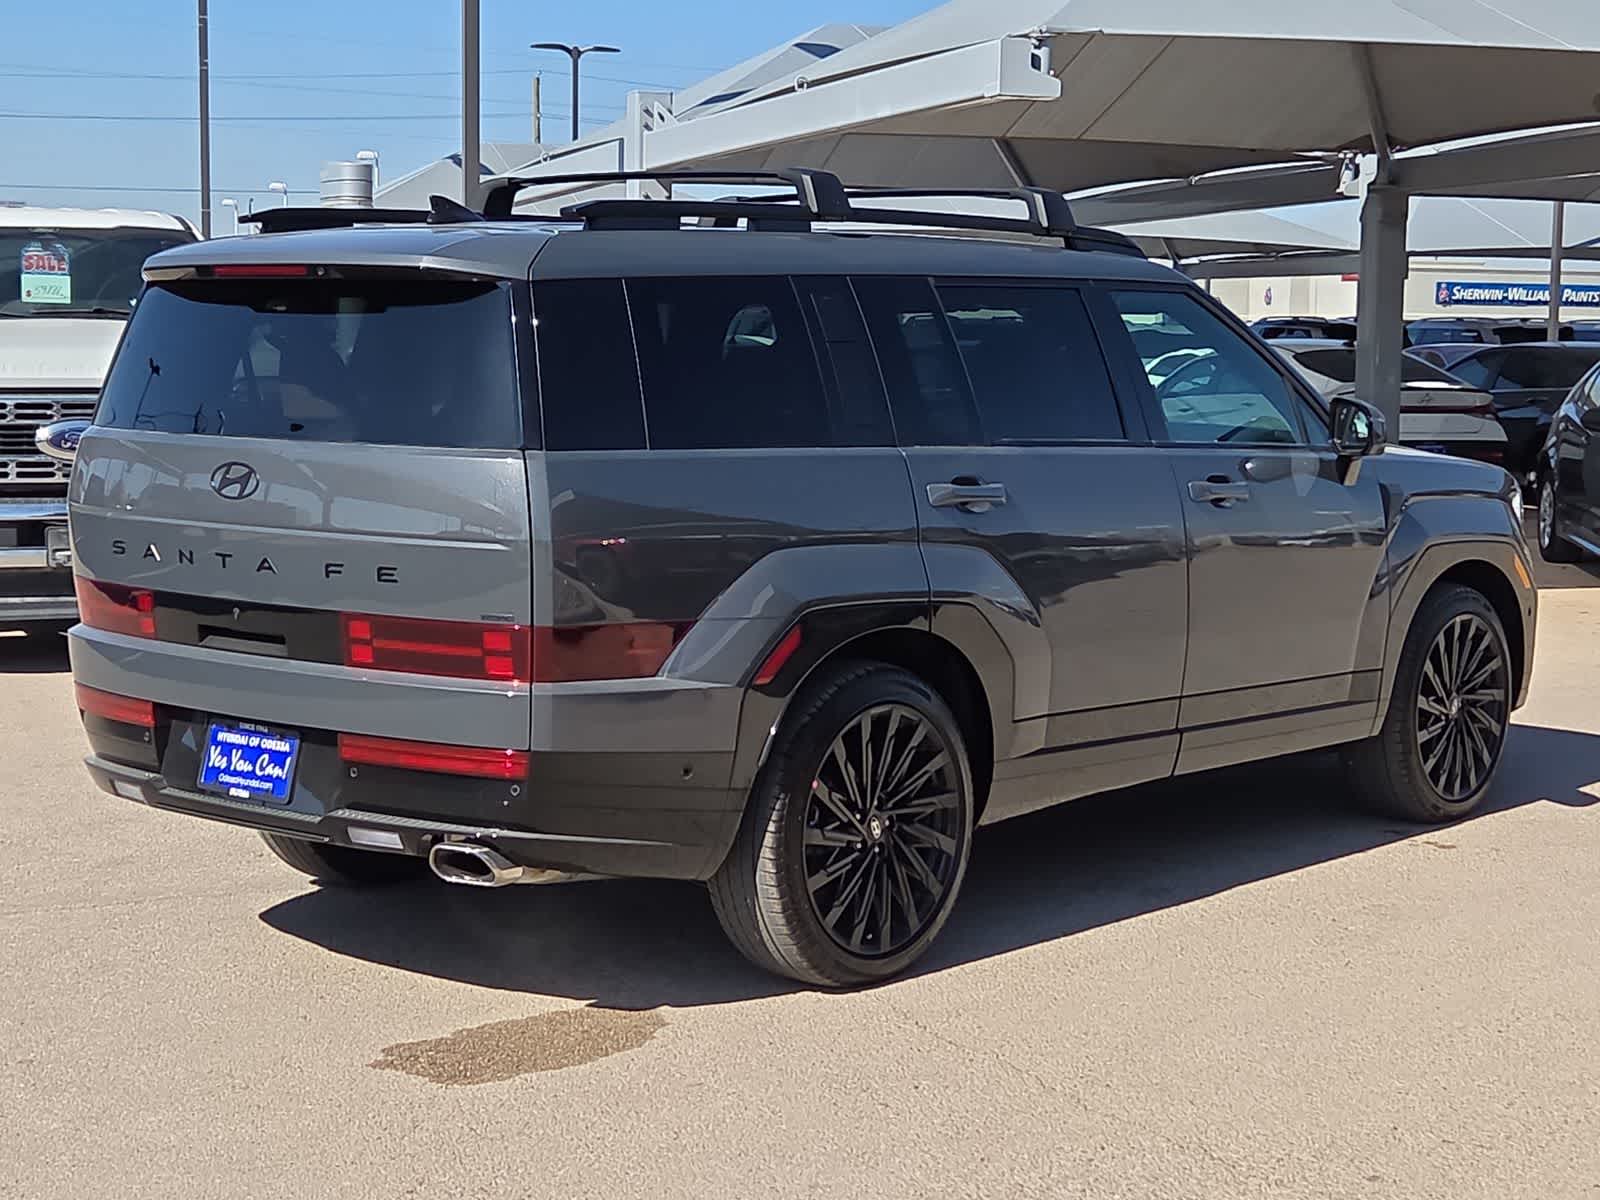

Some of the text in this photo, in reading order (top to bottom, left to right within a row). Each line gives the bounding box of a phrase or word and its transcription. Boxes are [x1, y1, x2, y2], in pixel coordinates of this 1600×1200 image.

[24, 254, 66, 271] SALE
[1562, 288, 1600, 302] PAINTS
[112, 540, 399, 584] SANTA FE
[248, 736, 261, 747] OF
[208, 745, 292, 780] Yes You Can!
